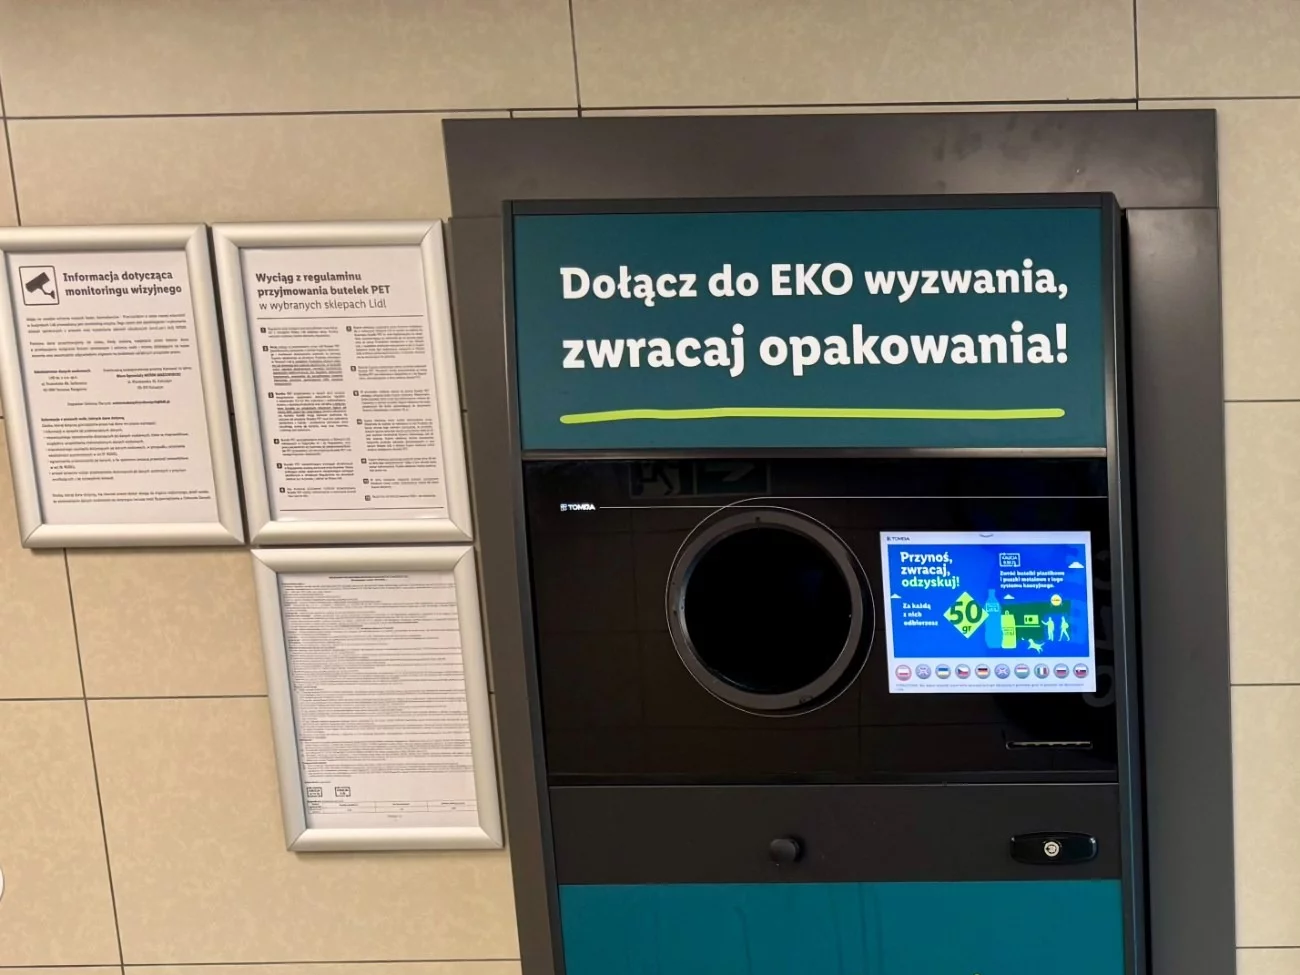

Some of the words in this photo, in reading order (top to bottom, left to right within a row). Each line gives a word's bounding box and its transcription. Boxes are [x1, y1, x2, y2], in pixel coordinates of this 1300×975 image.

[63, 271, 119, 282] Informacja
[122, 271, 173, 282] dotycząca
[256, 272, 293, 284] Wyciąg
[303, 271, 362, 283] regulaminu
[560, 266, 697, 306] Dołącz
[708, 264, 758, 297] do
[772, 263, 853, 295] EKO
[864, 258, 1067, 303] wyzwania,
[65, 286, 128, 297] monitoringu
[131, 284, 182, 296] wizyjnego
[257, 286, 328, 298] przyjmowania
[330, 285, 368, 295] butelek
[371, 285, 390, 294] PET
[270, 300, 322, 312] wybranych
[324, 300, 366, 310] sklepach
[369, 299, 386, 308] Lidl
[563, 324, 744, 377] zwracaj
[760, 320, 1067, 376] opakowania!
[900, 552, 952, 565] Przynoś,
[901, 564, 950, 578] zwracaj,
[902, 576, 959, 589] odzyskuj!
[949, 600, 982, 625] 50
[962, 626, 973, 634] gr
